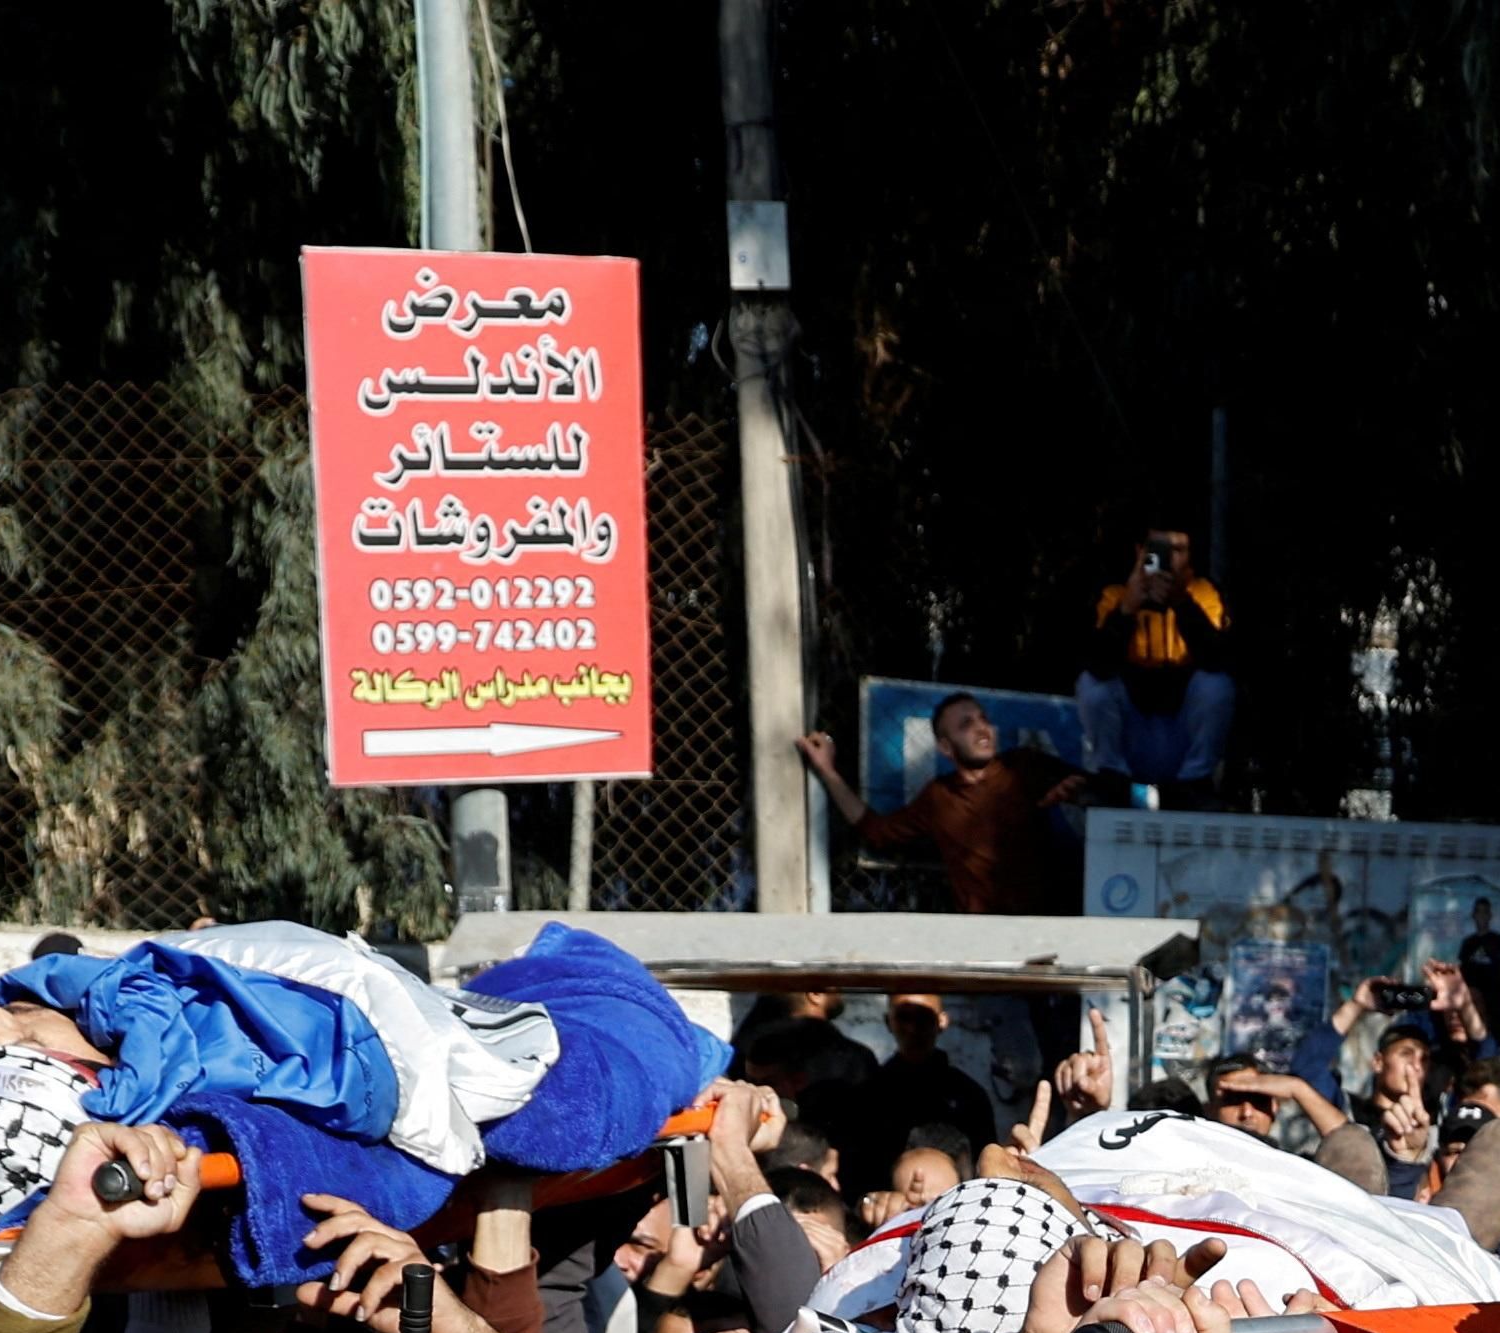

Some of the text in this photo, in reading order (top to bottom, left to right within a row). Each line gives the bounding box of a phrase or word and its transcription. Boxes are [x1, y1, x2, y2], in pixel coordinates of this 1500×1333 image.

[385, 268, 570, 337] معرض
[360, 337, 599, 411] الأندلس
[375, 421, 588, 486] للستائر
[354, 494, 616, 561] والمفروشات
[369, 577, 595, 610] 0592-012292
[372, 619, 596, 653] 0599-742402
